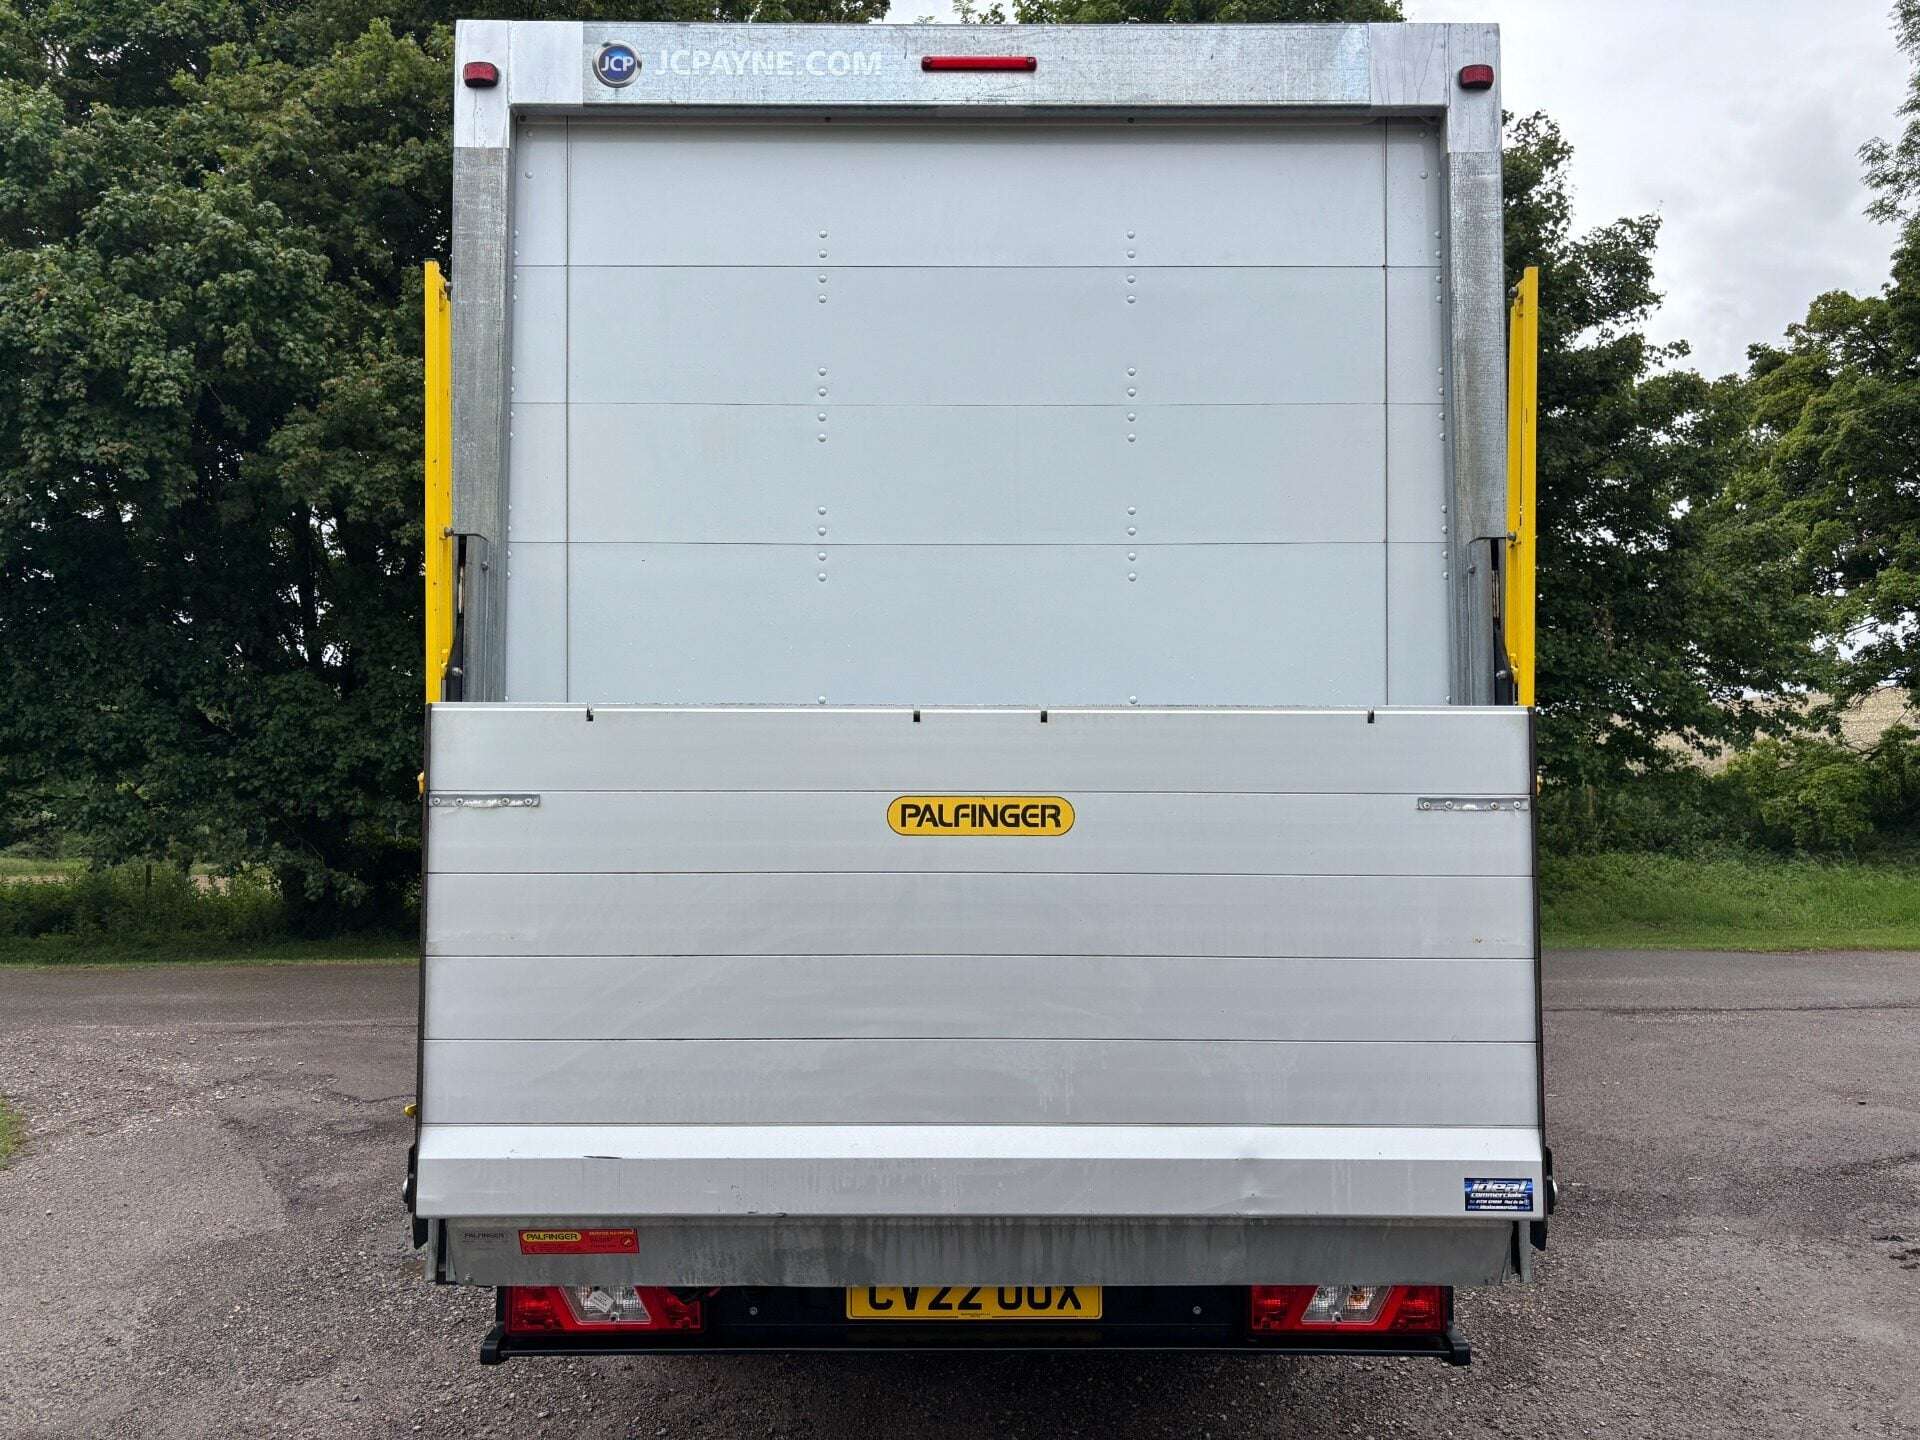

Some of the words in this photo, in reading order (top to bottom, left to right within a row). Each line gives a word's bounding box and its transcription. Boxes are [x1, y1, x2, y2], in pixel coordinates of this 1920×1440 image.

[600, 56, 635, 72] JCP
[655, 50, 882, 77] JCPAYNE.COM
[900, 803, 1062, 828] PALFINGER
[1472, 1180, 1528, 1192] ideal
[526, 1232, 579, 1241] PALFINGER
[868, 1286, 982, 1311] CV22
